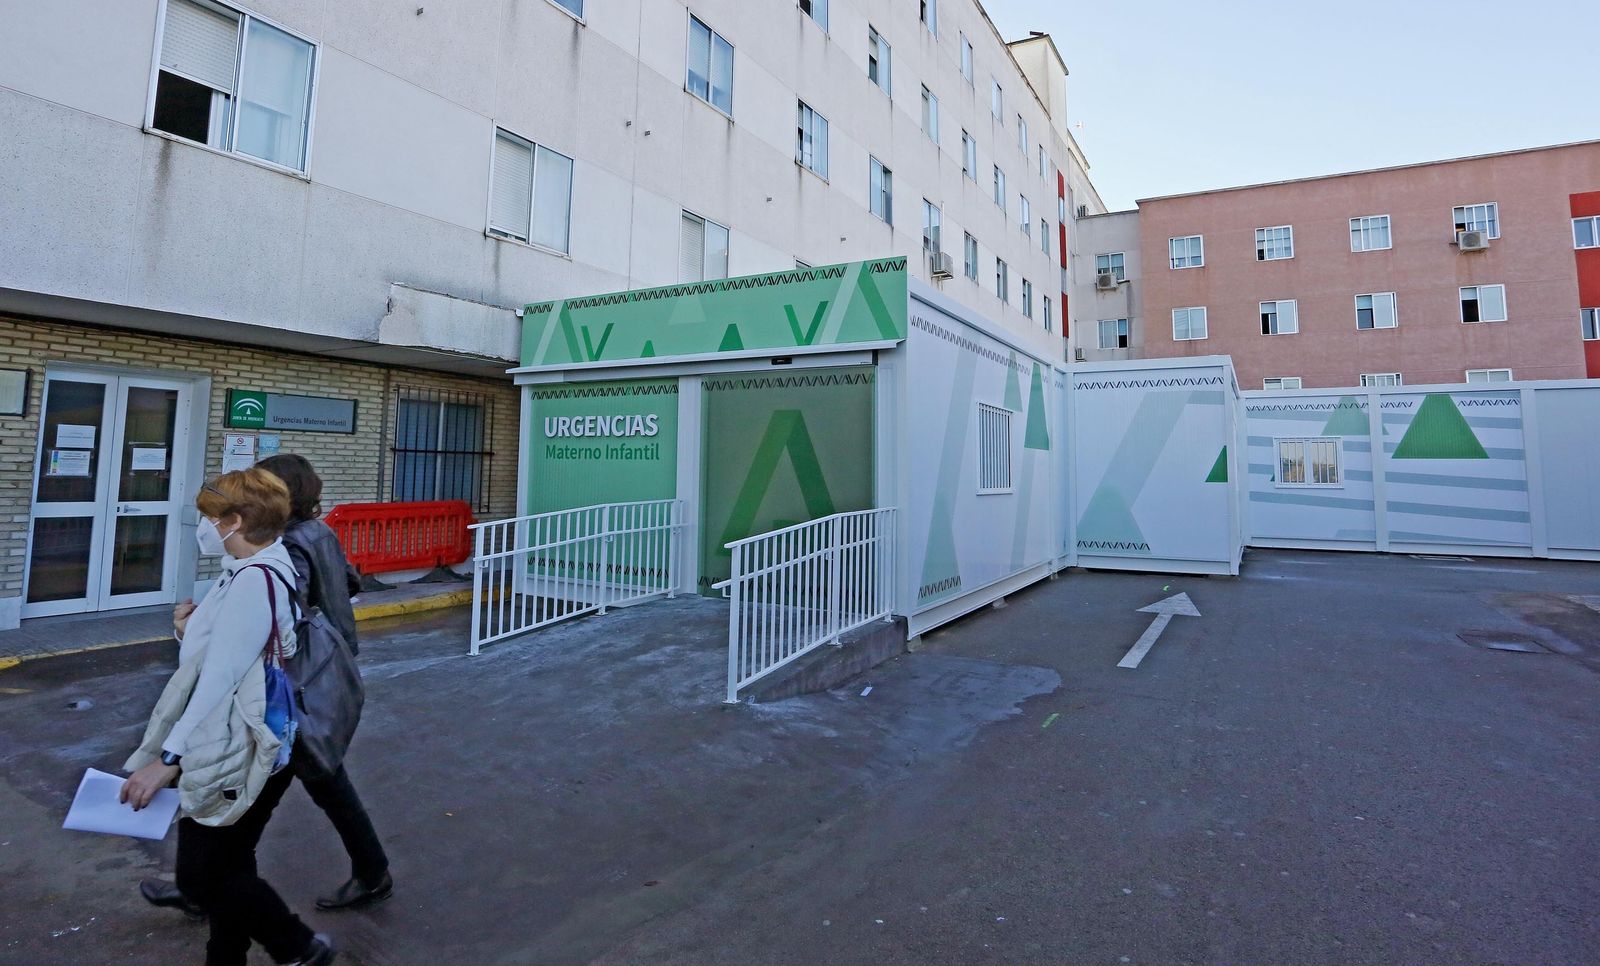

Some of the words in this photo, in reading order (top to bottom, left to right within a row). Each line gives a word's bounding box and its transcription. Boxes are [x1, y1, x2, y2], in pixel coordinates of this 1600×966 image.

[273, 416, 302, 424] Urgencias
[304, 417, 326, 425] Materno
[544, 414, 659, 437] URGENCIAS
[545, 444, 602, 460] Materno
[605, 442, 660, 460] Infantil
